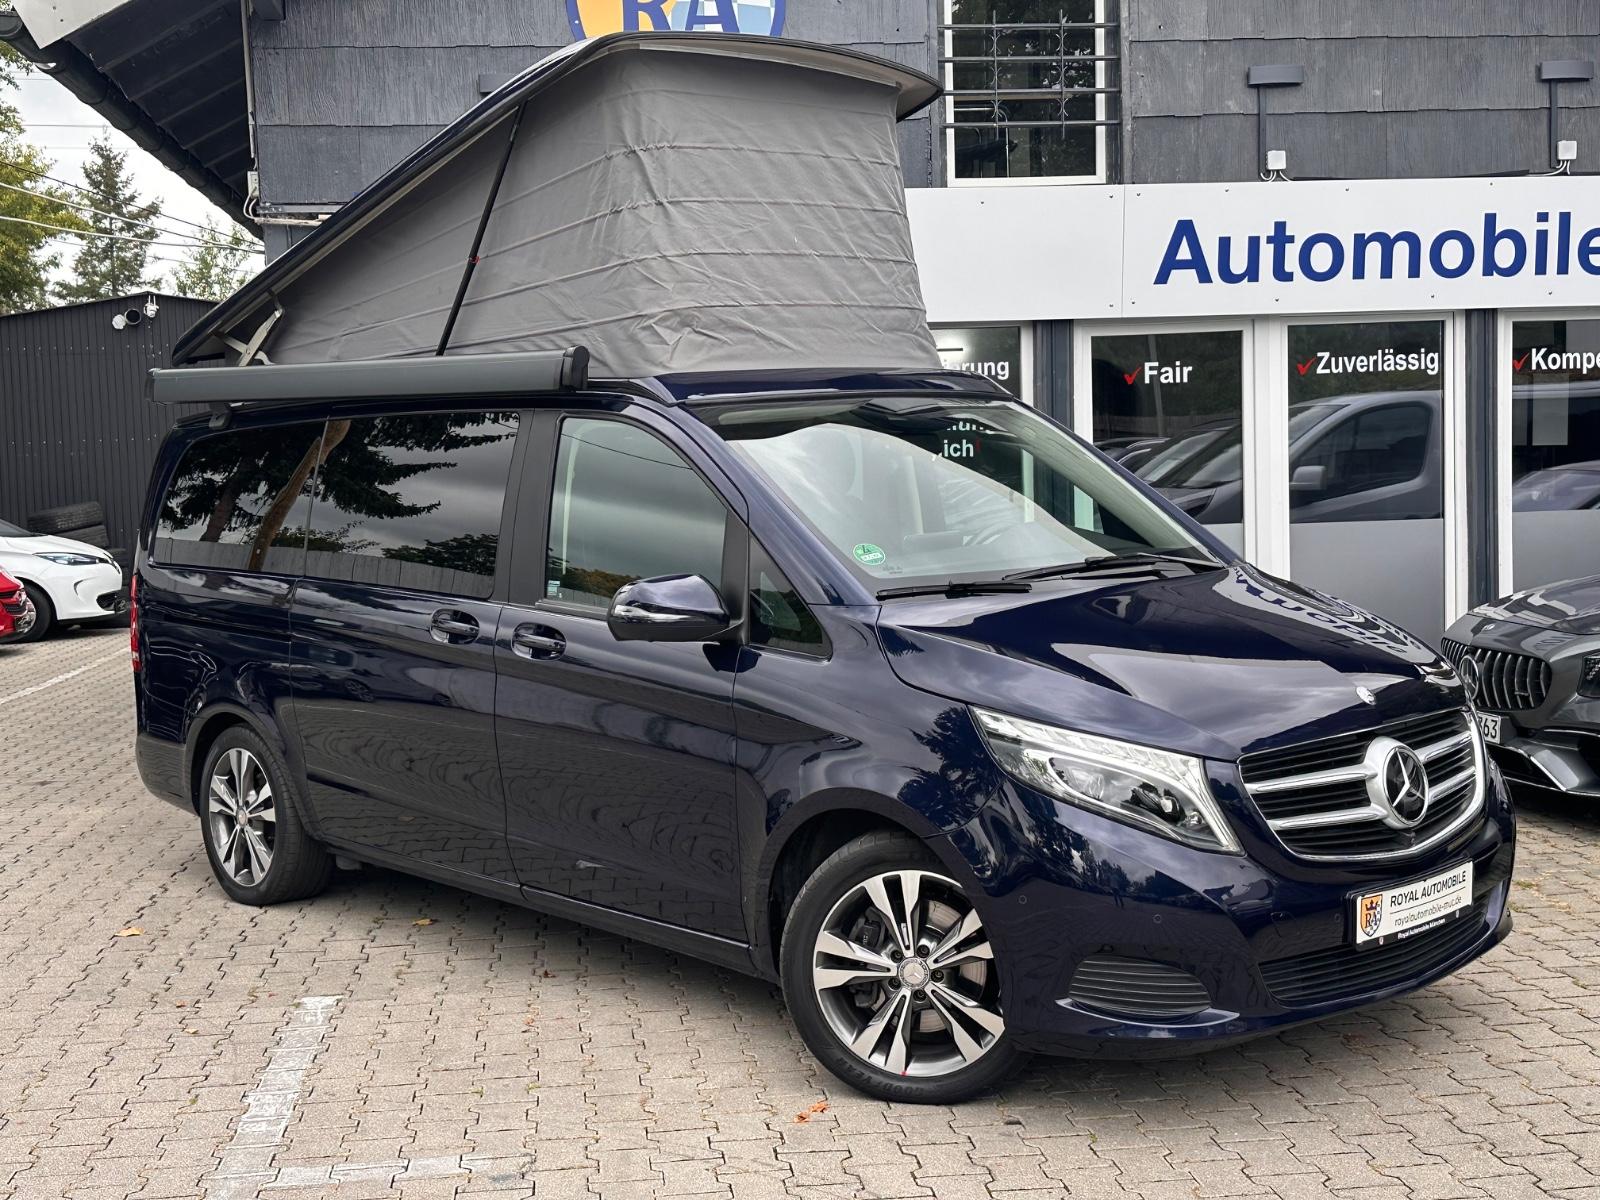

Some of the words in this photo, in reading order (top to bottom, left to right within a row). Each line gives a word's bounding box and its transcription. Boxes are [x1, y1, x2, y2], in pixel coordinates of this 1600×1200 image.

[1144, 361, 1193, 384] Fair
[1316, 348, 1439, 375] Zuverlässig
[1390, 889, 1419, 908] ROYAL
[1420, 870, 1466, 900] AUTOMOBILE
